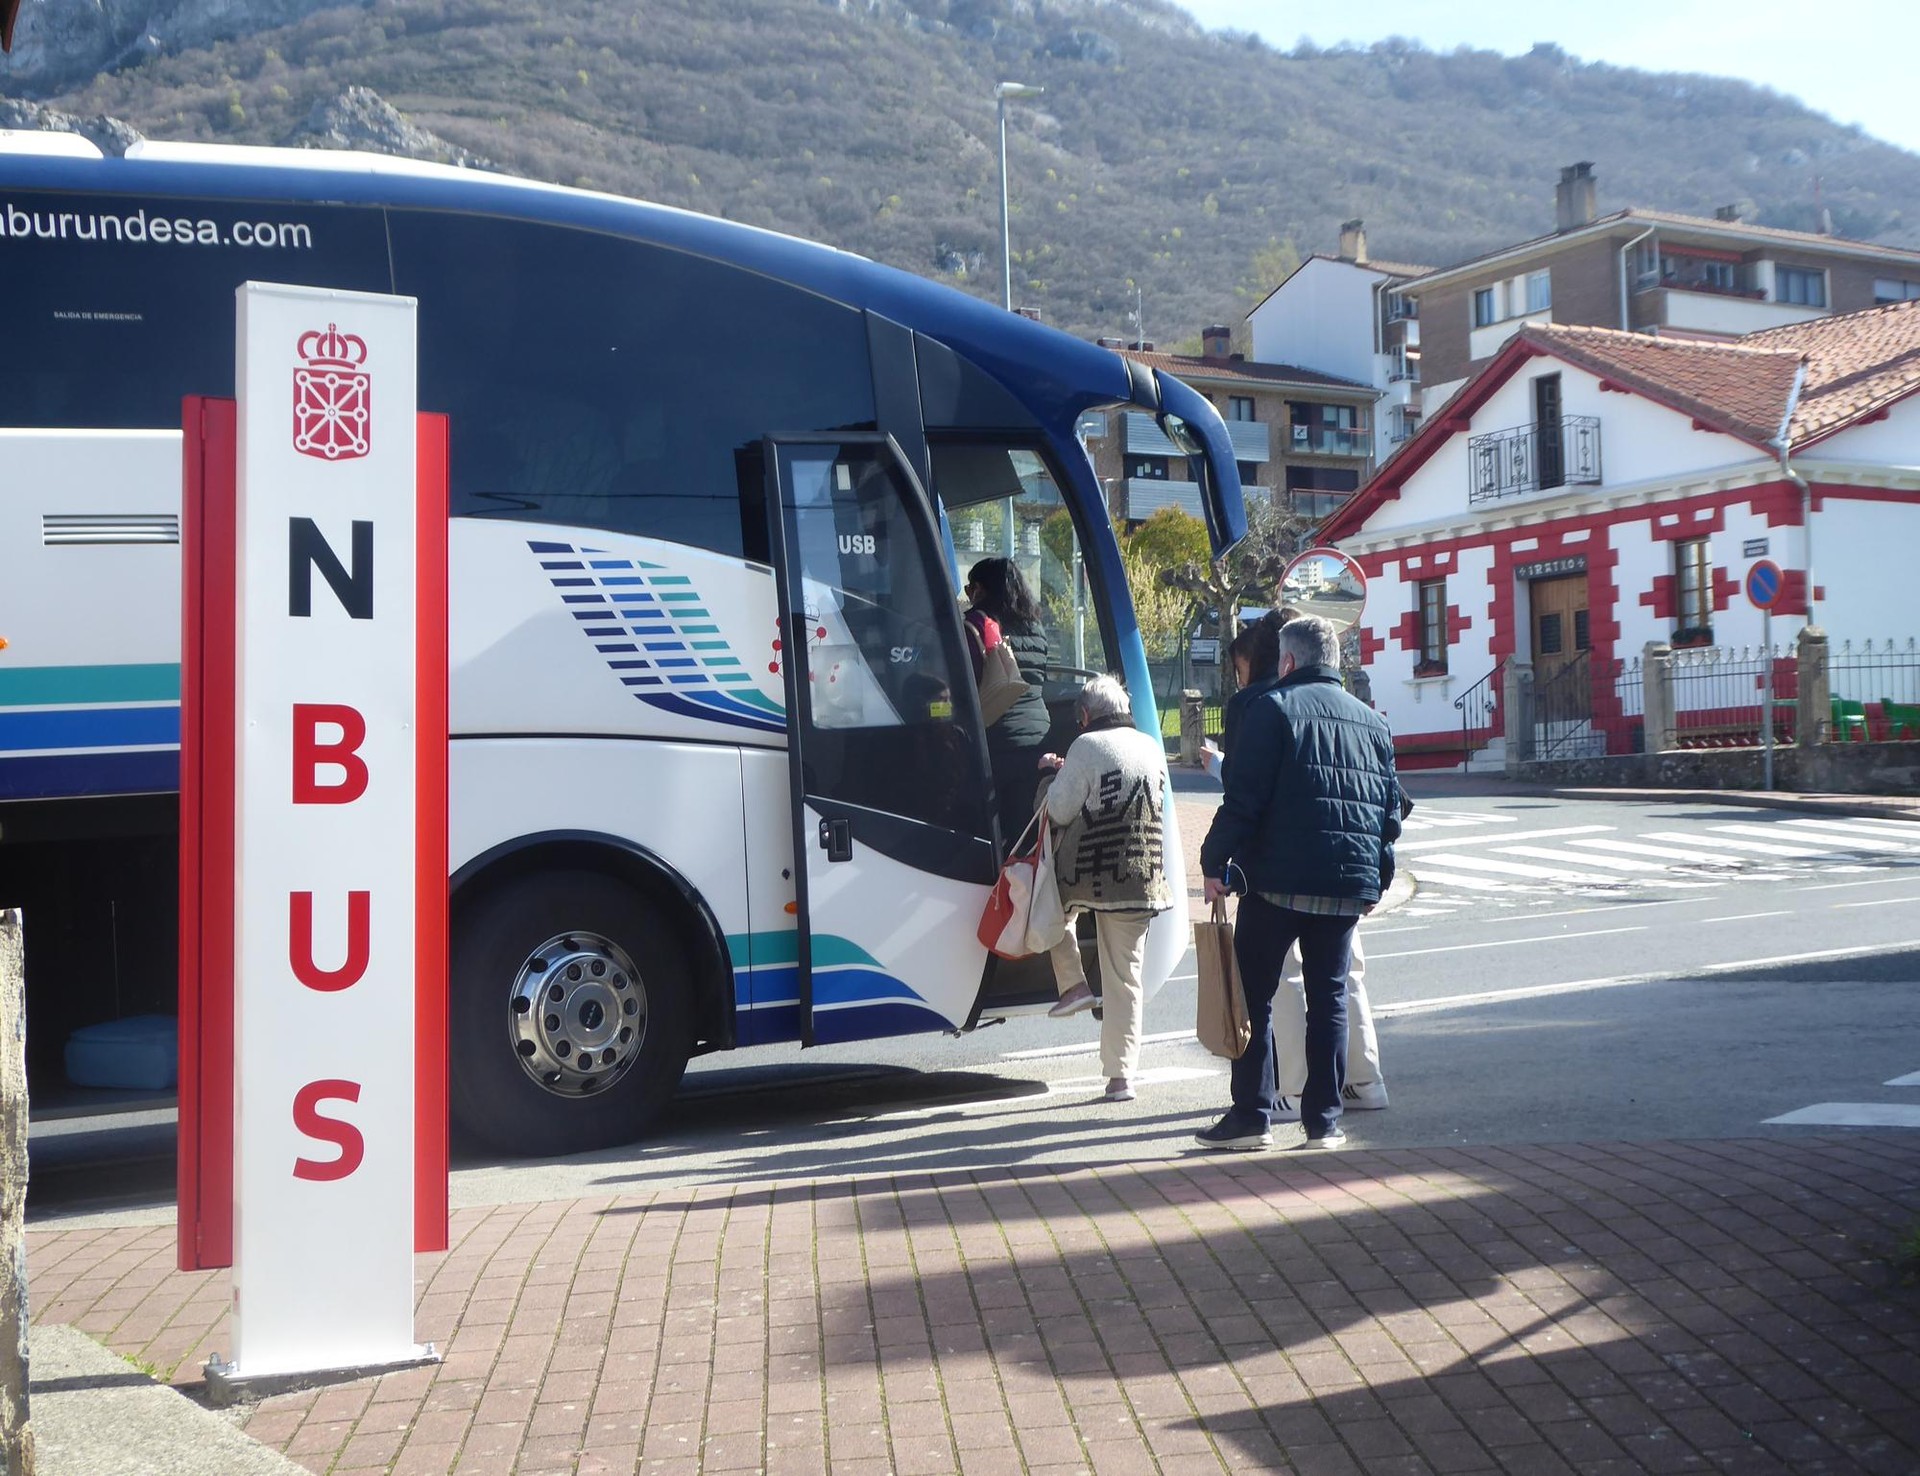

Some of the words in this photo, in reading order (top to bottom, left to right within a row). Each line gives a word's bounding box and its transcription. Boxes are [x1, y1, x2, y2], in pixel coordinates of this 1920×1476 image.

[54, 311, 80, 319] SALIDA
[94, 312, 142, 320] EMERGENCIA
[839, 535, 875, 554] USB
